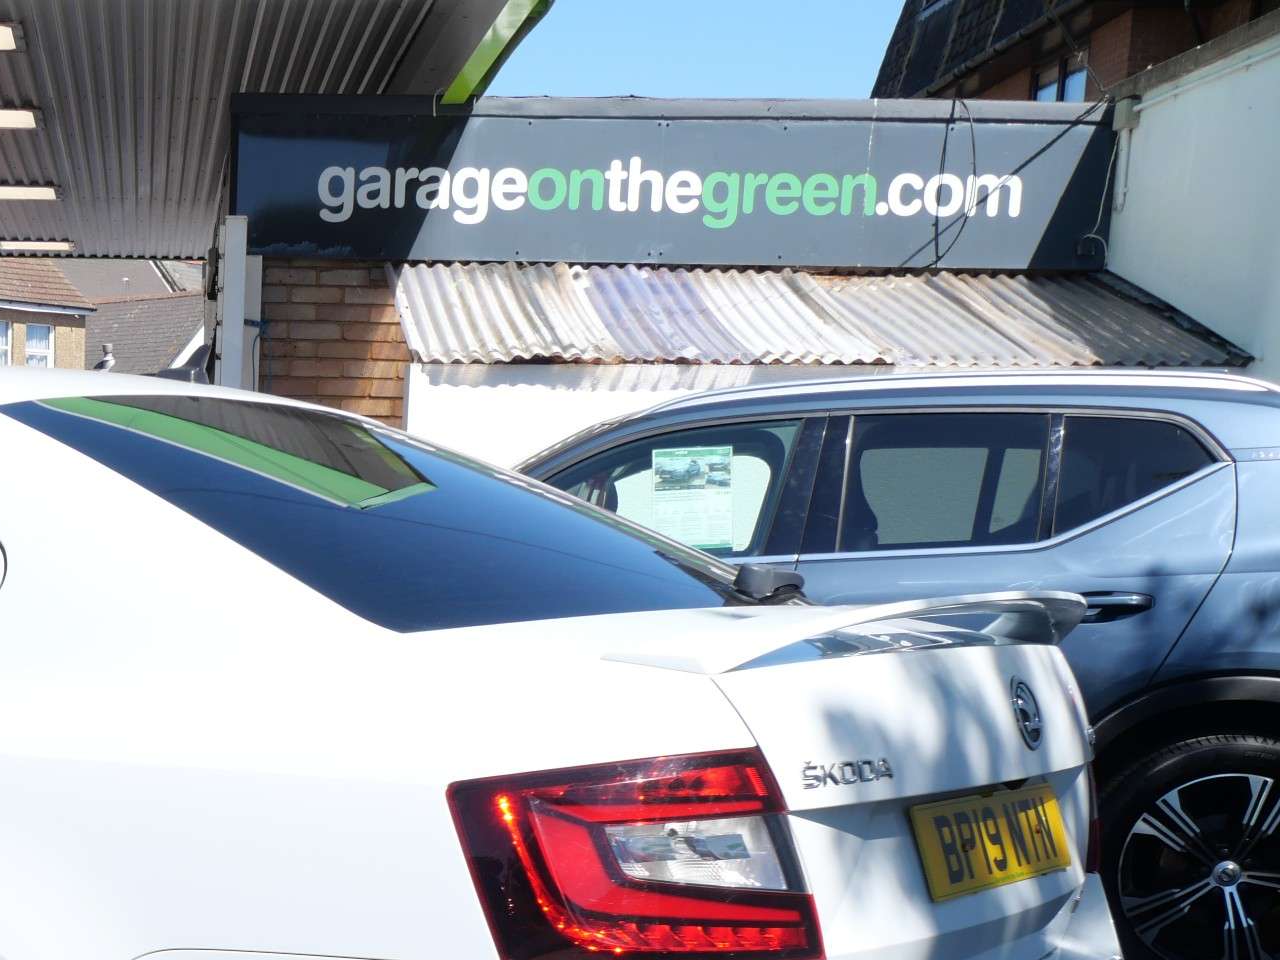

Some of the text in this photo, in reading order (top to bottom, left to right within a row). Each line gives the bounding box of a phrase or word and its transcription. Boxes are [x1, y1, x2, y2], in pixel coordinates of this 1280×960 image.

[318, 156, 1023, 227] garageonthegreen.com
[801, 758, 893, 790] ŠKODA
[933, 806, 1009, 885] BP19
